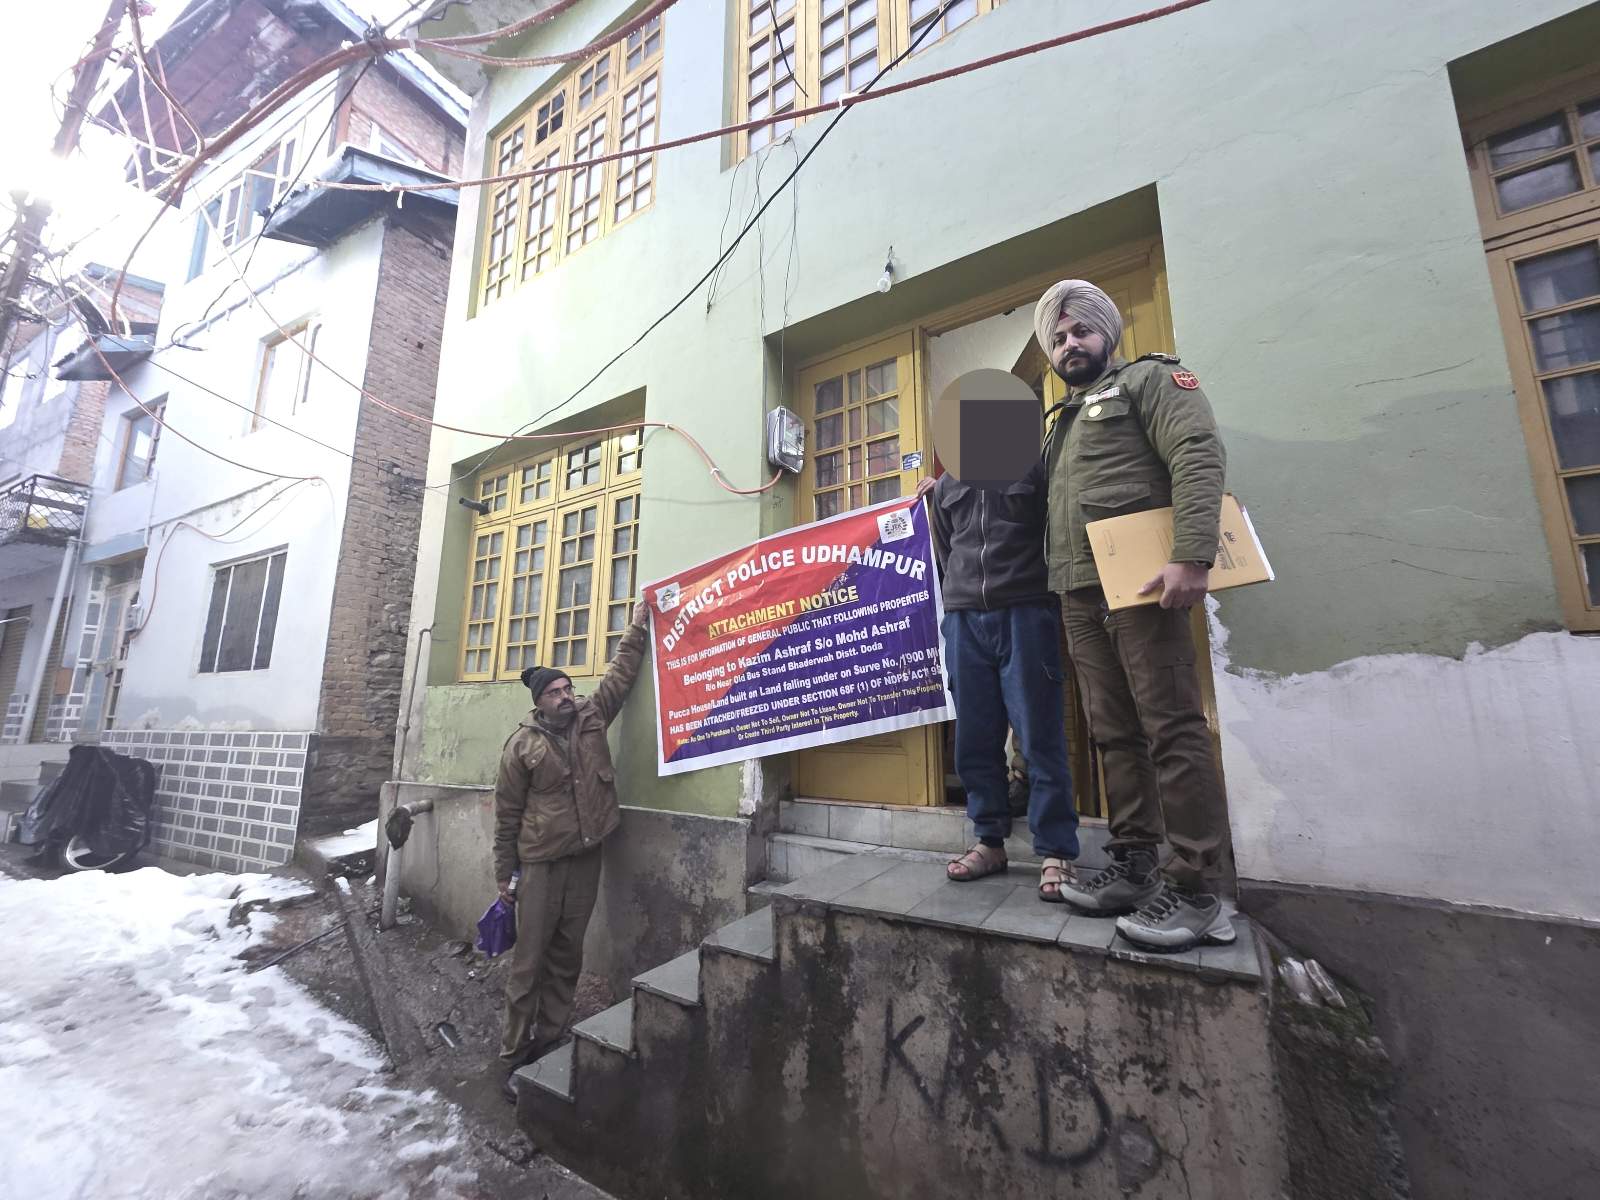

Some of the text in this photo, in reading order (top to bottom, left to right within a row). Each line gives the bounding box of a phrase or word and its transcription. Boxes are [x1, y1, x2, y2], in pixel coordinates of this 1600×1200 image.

[663, 544, 926, 652] DISTRICT POLICE UDHAMPUR
[666, 590, 929, 670] THIS IS FOR INFORMATION OF GENERAL PUBLIC THAT FOLLOWING PROPERTIES
[708, 585, 859, 639] ATTACHMENT NOTICE
[683, 616, 911, 686] Belonging to Kazim Ashraf S/o Mohd Ashraf
[716, 679, 733, 690] Near
[734, 674, 745, 685] Old
[746, 669, 760, 681] Bus
[762, 663, 786, 677] Stand
[787, 652, 834, 671] Bhaderwah
[835, 646, 859, 660] Distt.
[860, 641, 883, 654] Doda
[668, 708, 690, 721] Pucca
[690, 695, 729, 714] House/Land
[729, 690, 748, 704] built
[748, 688, 758, 699] on
[759, 682, 782, 697] Land
[783, 678, 811, 692] falling
[812, 671, 838, 685] under
[840, 668, 851, 679] on
[853, 660, 881, 676] Surve
[882, 657, 899, 669] No.
[670, 724, 684, 735] HAS
[685, 719, 703, 731] BEEN
[703, 703, 770, 727] ATTACHED/FREEZED
[771, 696, 801, 711] UNDER
[801, 687, 839, 704] SECTION
[839, 683, 855, 695] 68F
[857, 680, 869, 694] (1)
[870, 677, 882, 689] OF
[883, 671, 909, 686] NDPS
[782, 713, 799, 722] Owner
[800, 710, 810, 718] Not
[838, 701, 856, 710] Owner
[857, 698, 868, 706] Not
